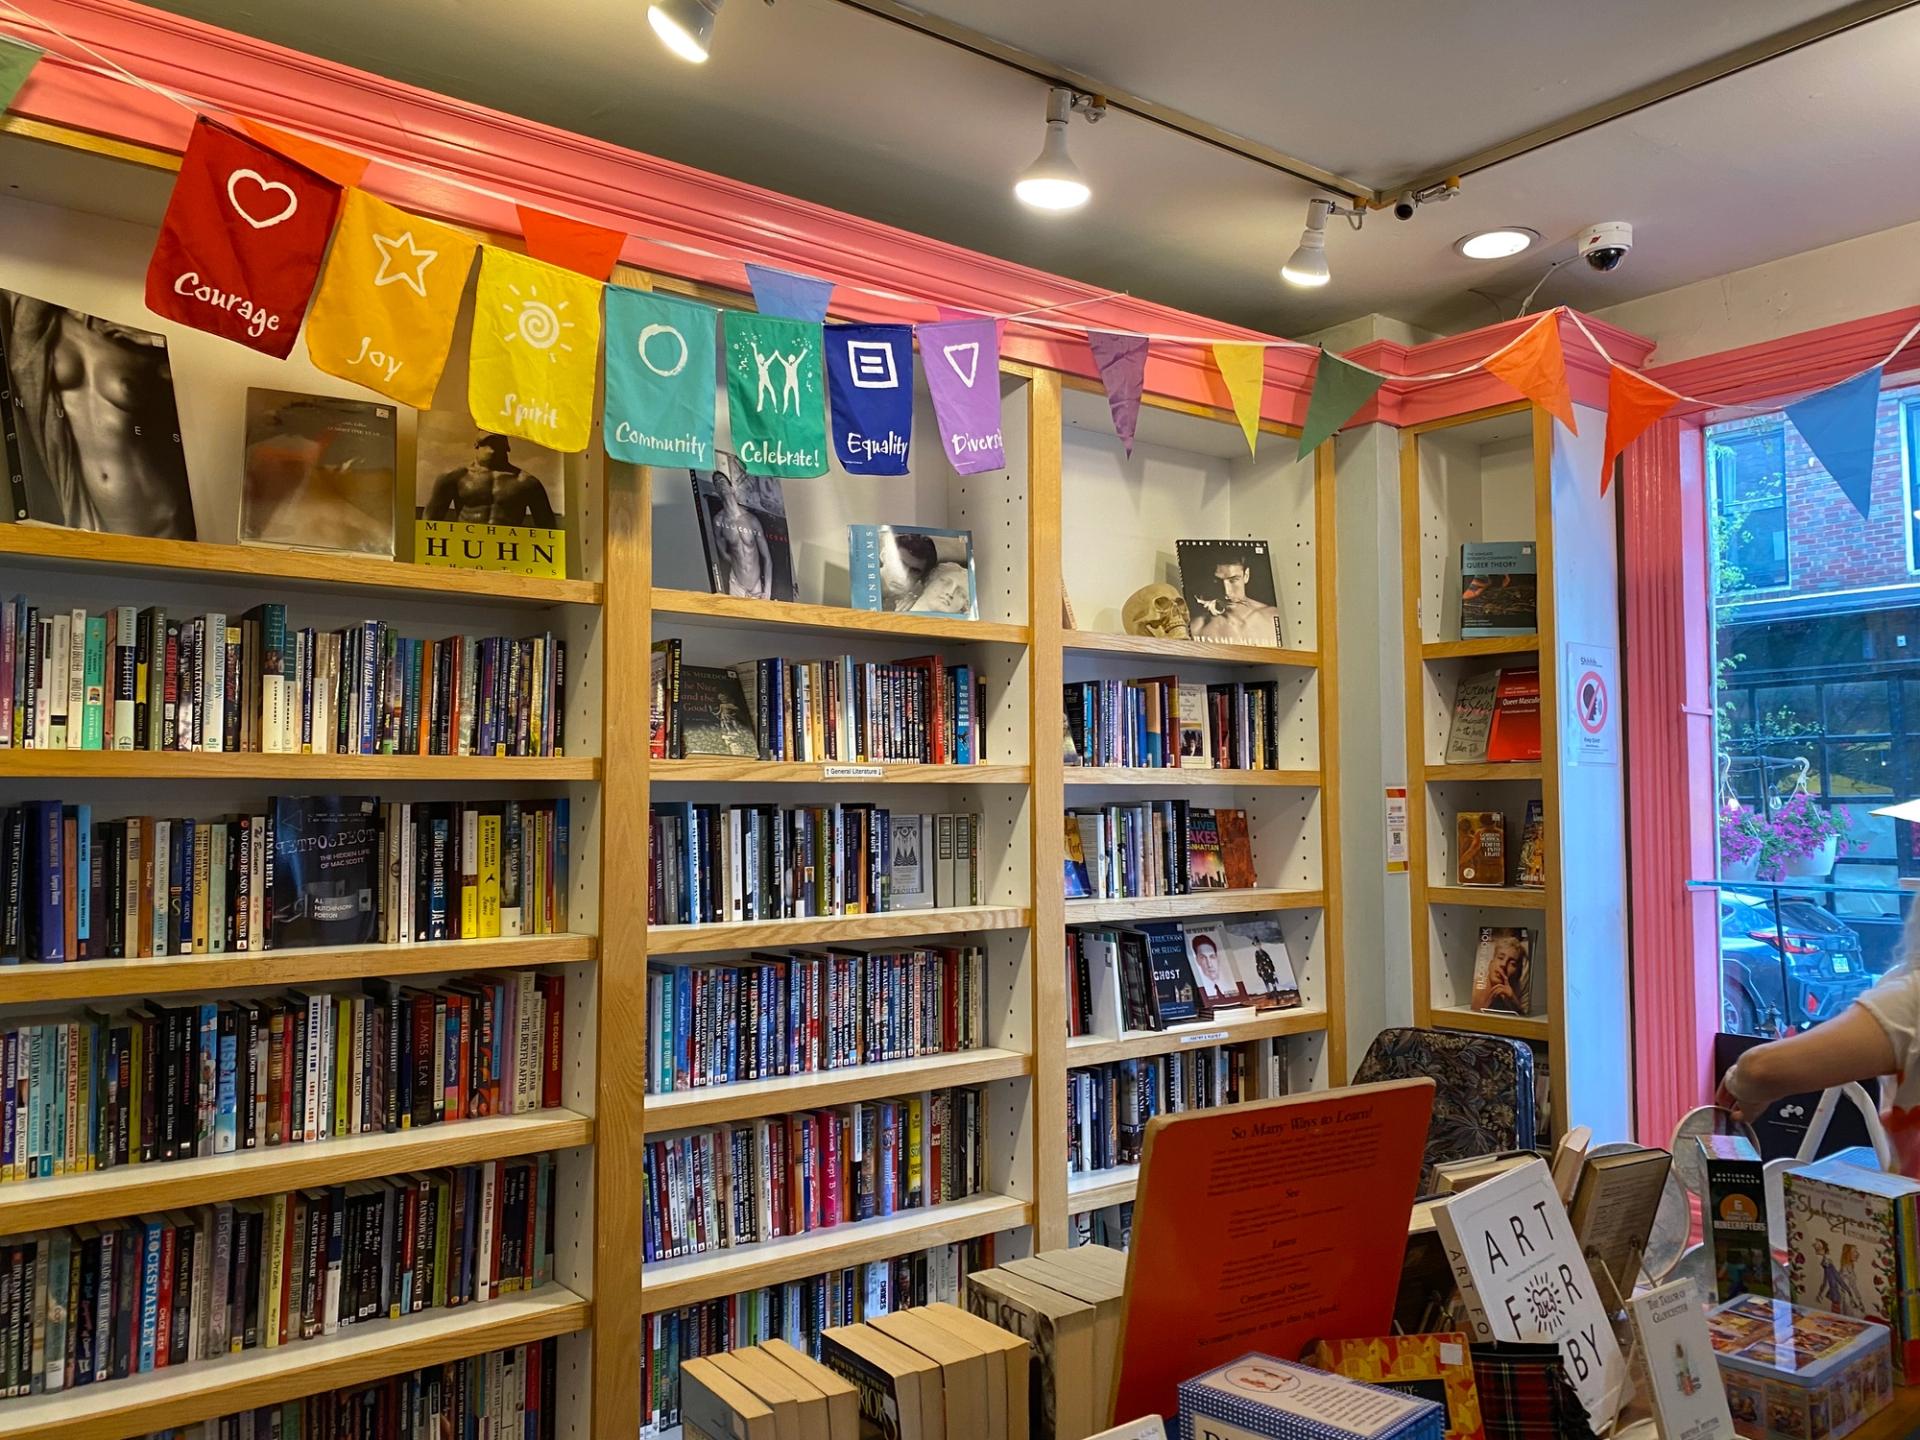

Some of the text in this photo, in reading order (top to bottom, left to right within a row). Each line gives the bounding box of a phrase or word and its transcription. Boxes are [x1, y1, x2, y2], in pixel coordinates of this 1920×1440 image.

[172, 271, 281, 339] Courage
[346, 336, 404, 384] Joy
[499, 393, 559, 429] Spirit
[615, 420, 707, 463] Community
[740, 440, 821, 469] Celebrate!
[847, 432, 909, 463] Equality
[424, 521, 557, 540] MICHAEL
[425, 536, 554, 564] HUHN
[1466, 560, 1517, 569] QUEER THEORY
[865, 529, 878, 612] SUNBEAMS
[29, 610, 38, 648] SOMEWHERE
[155, 613, 164, 672] THE CHINTZ AGE
[28, 648, 36, 665] OVER
[214, 617, 225, 699] STEPS GOING DOWN
[364, 630, 375, 661] COMING
[673, 648, 681, 659] The
[364, 663, 374, 687] HOME
[760, 669, 768, 694] Getting
[830, 767, 878, 776] General Literature
[1189, 831, 1219, 844] AKES
[9, 823, 21, 903] THE LAST CASTRATO
[194, 849, 202, 878] BISLEY
[265, 831, 274, 889] FINAL BELL
[333, 851, 357, 860] HIDDEN
[345, 857, 364, 865] SCOTT
[194, 879, 202, 897] BOY
[239, 829, 249, 938] NO GOOD REASON CARI HUNTER
[431, 830, 445, 925] CONFLICT INTEREST JAE
[1153, 968, 1181, 981] GHOST
[715, 986, 723, 1037] CROSSROADS
[750, 979, 758, 1034] FIRESTORM
[7, 1038, 16, 1062] FINDERS
[70, 1027, 78, 1051] JUST
[355, 1036, 363, 1060] HOUSE
[418, 1020, 431, 1087] JAMES LEAR
[551, 1011, 560, 1072] THE COLLECTION
[69, 1055, 77, 1077] LIKE
[219, 1035, 237, 1105] KISS TELL
[518, 1016, 530, 1095] THE DREYFUS AFFAIR
[6, 1063, 15, 1089] KEEPERS
[31, 1066, 40, 1088] MOON
[1231, 1105, 1374, 1141] So Many Ways to Learn!
[417, 1199, 428, 1234] RAINBOW
[1713, 1220, 1767, 1231] MINECRAFTERS
[416, 1235, 424, 1250] GAP
[1483, 1200, 1554, 1275] ART
[142, 1229, 161, 1348] ROCKSTARLET
[879, 1280, 887, 1310] CHOICES
[1449, 1250, 1490, 1336] ART FO
